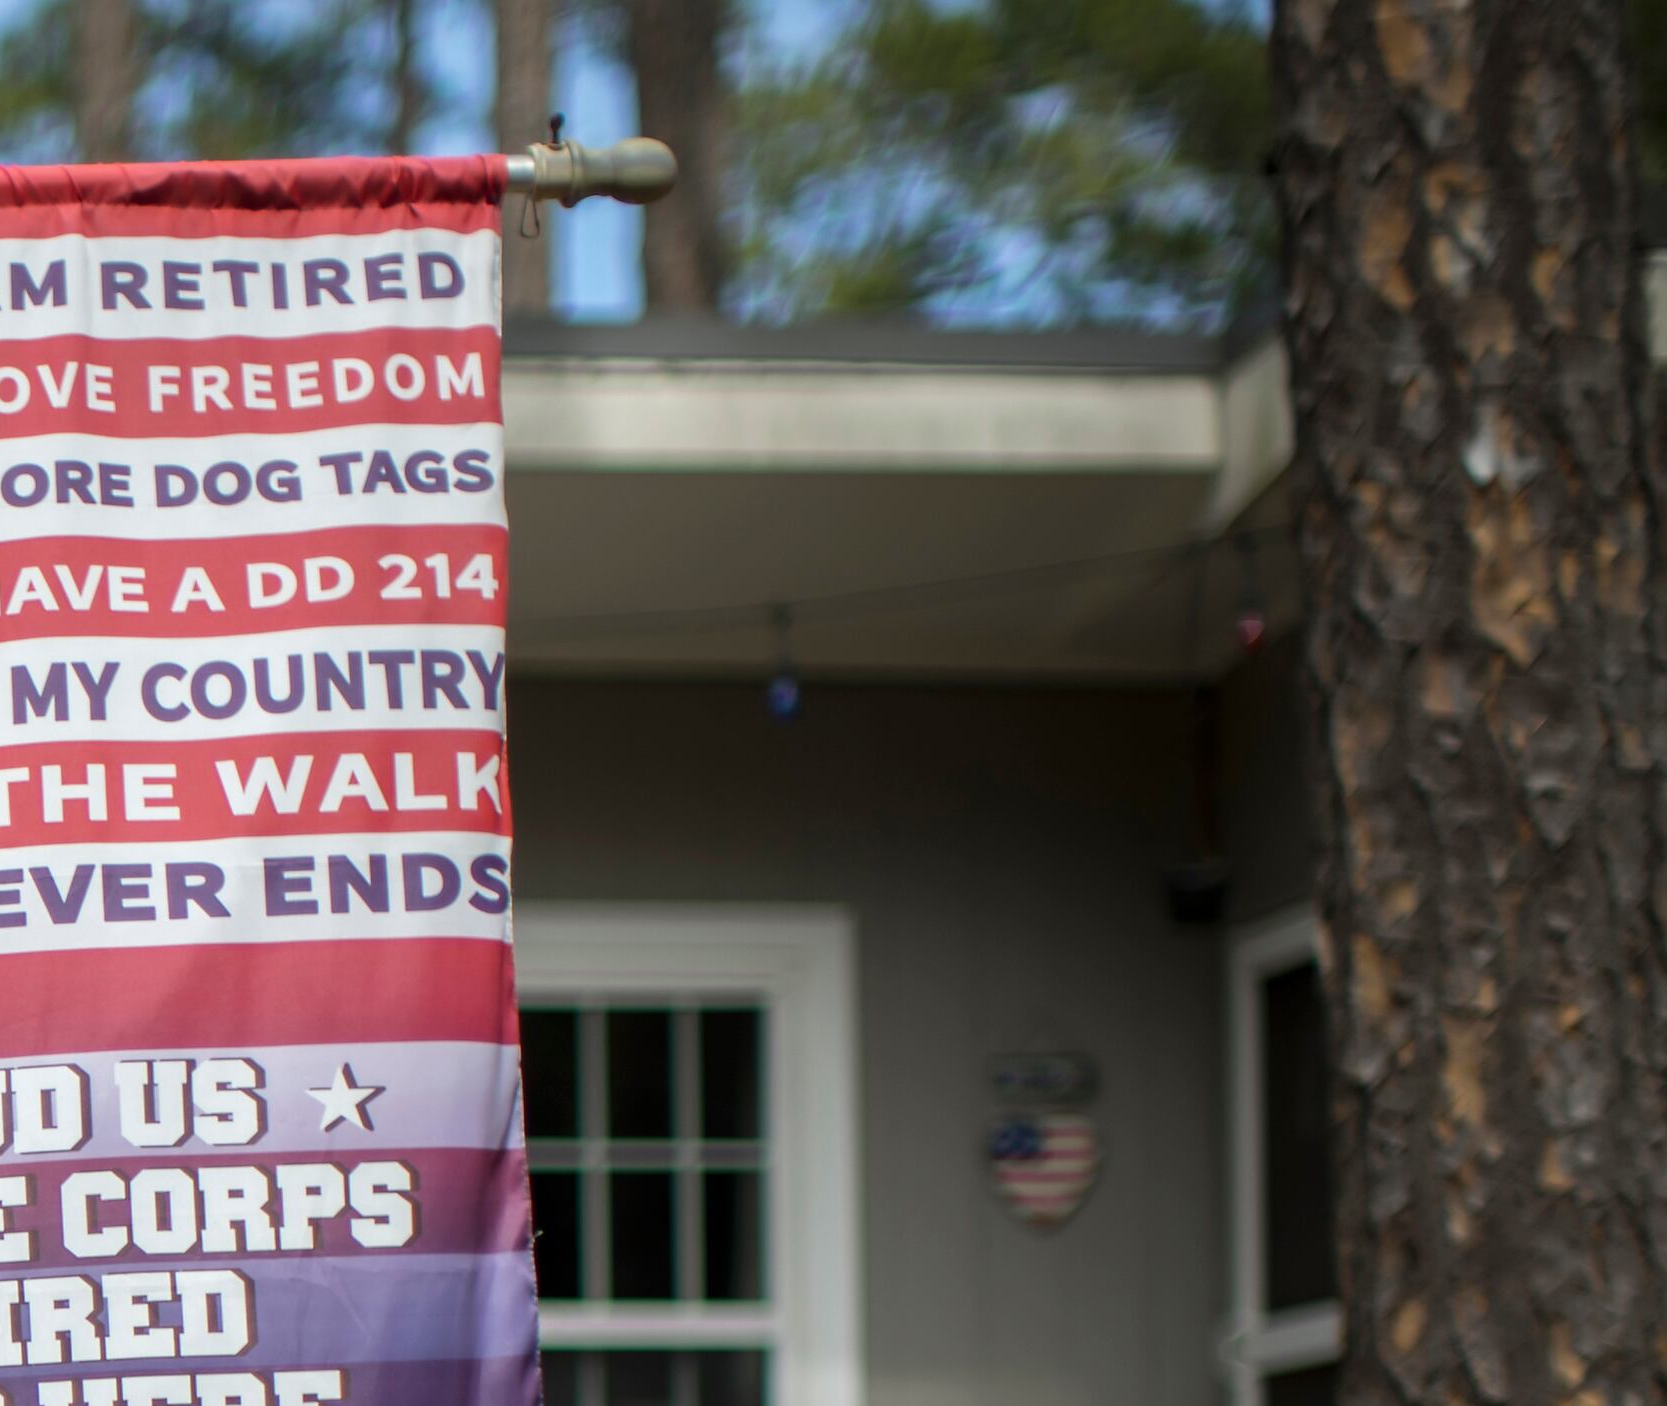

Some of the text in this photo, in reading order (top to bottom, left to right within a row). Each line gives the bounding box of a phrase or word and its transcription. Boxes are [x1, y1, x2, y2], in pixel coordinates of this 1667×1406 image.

[99, 251, 465, 311] RETIRED
[147, 352, 486, 414] FREEDOM
[153, 459, 302, 508] DOG
[319, 449, 496, 495] TAGS
[171, 566, 226, 613] A
[247, 555, 355, 604] DD
[379, 552, 499, 601] 214
[11, 660, 122, 722] MY
[140, 649, 505, 721] COUNTRY
[215, 751, 502, 817] WALK
[262, 850, 510, 918] ENDS
[114, 1058, 267, 1147] US
[60, 1159, 419, 1260] CORPS
